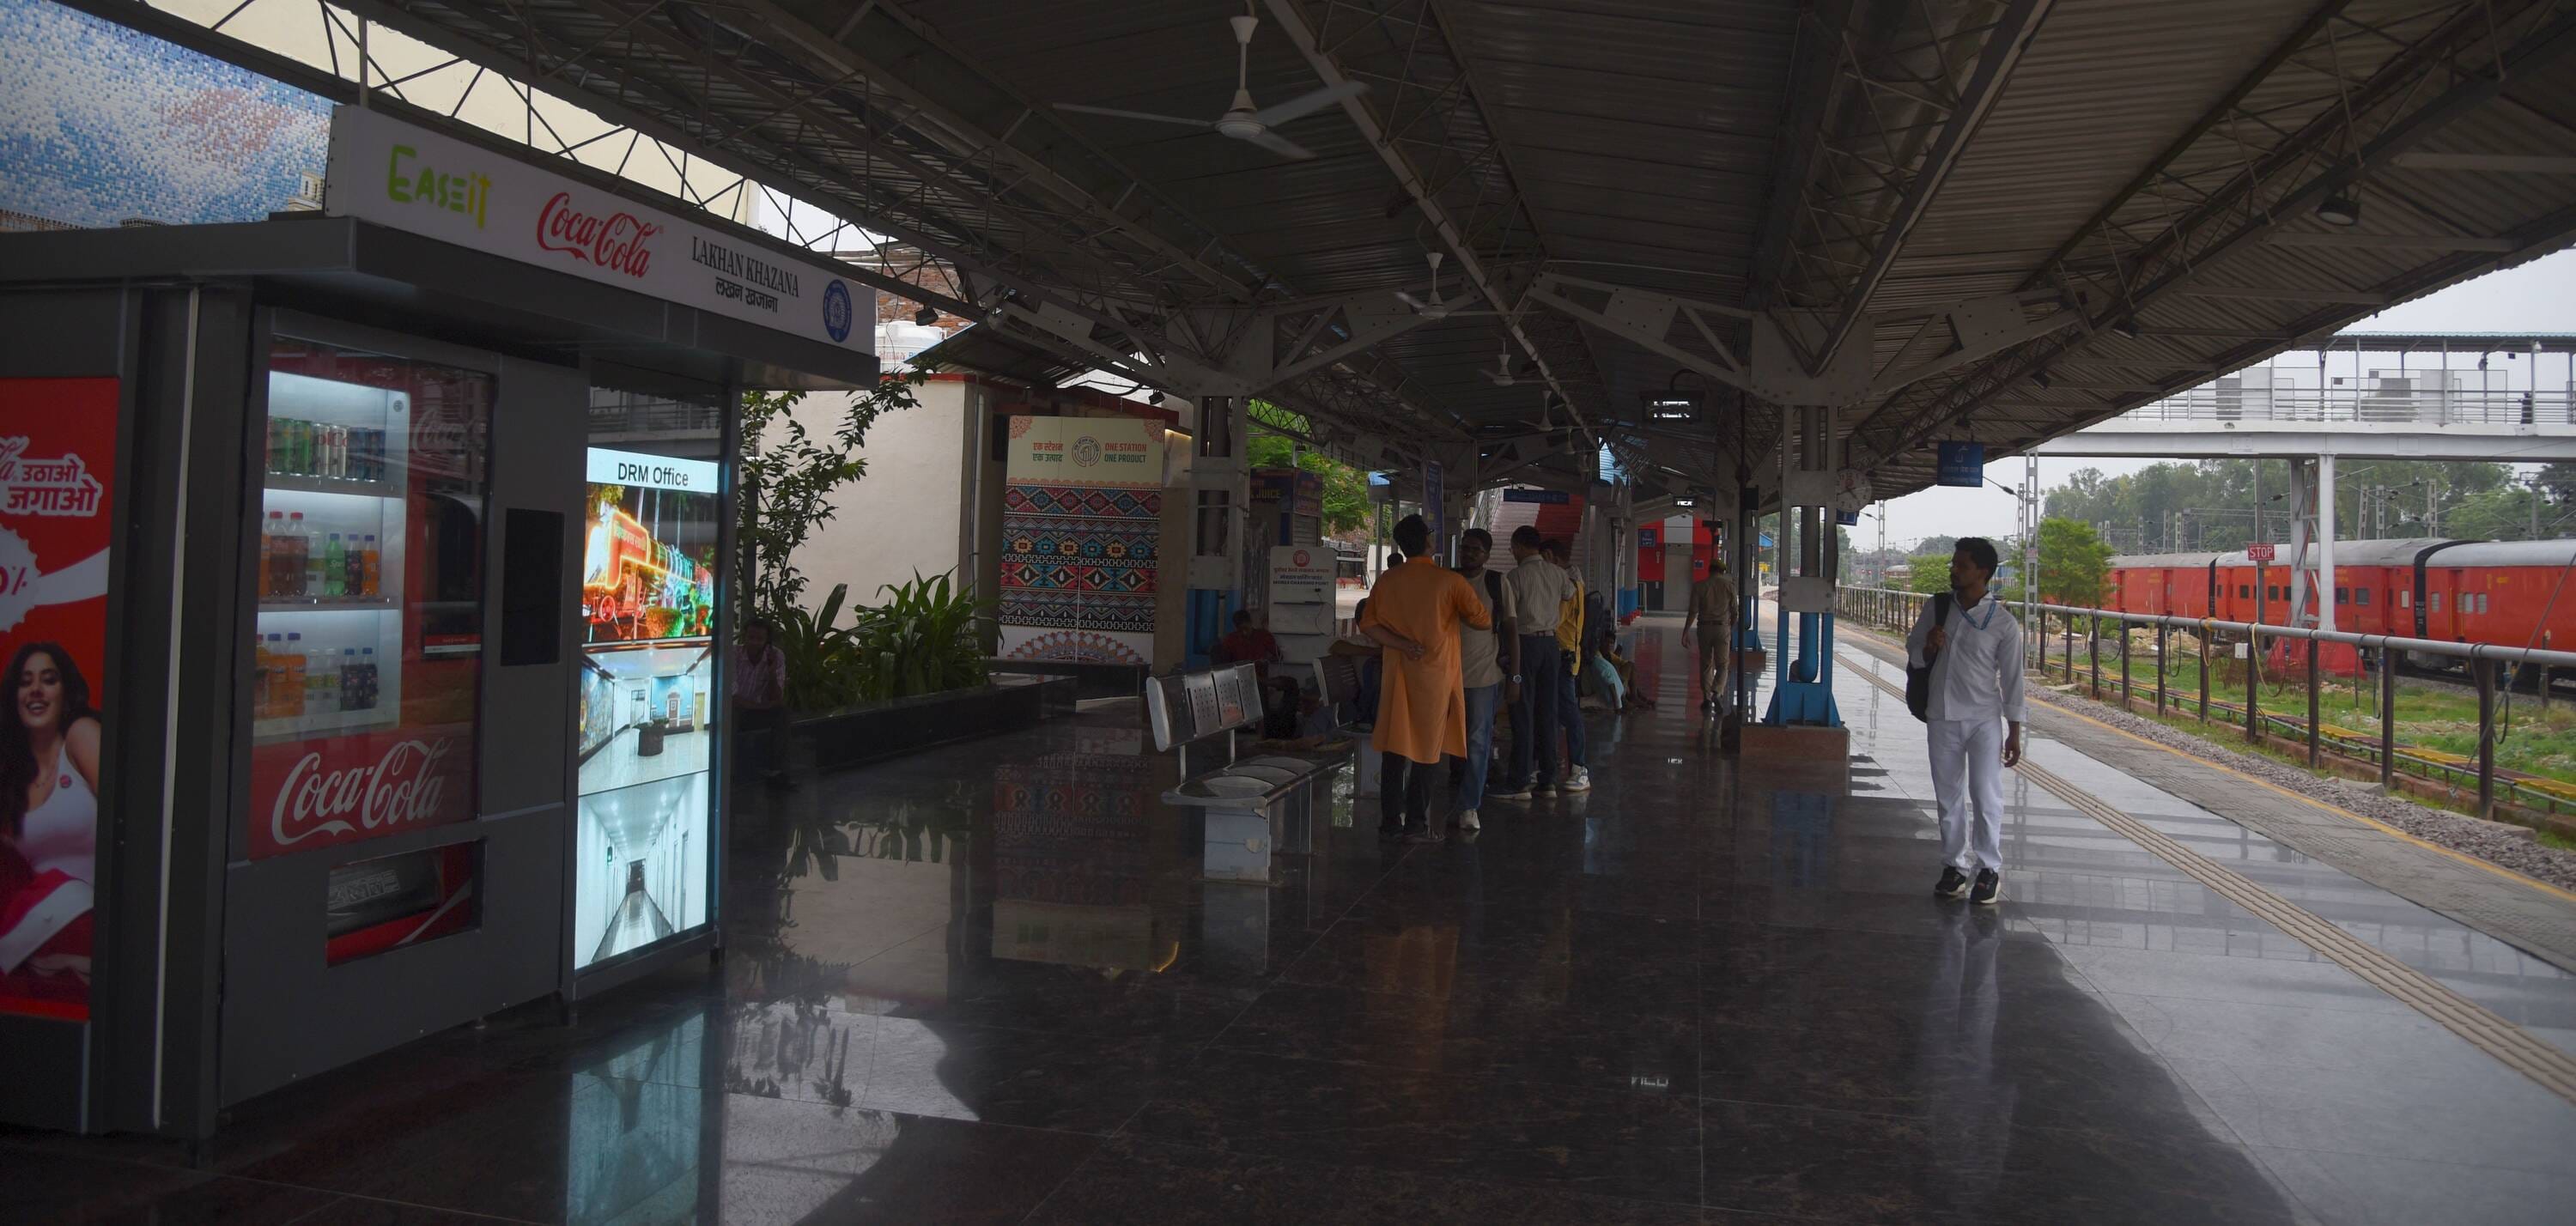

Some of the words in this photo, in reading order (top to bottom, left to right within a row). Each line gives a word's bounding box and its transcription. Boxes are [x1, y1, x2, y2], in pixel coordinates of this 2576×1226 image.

[692, 236, 744, 277] LAKHAN
[745, 257, 799, 298] KHAZANA
[715, 276, 744, 301] लखन
[744, 288, 779, 313] खजाना
[1033, 442, 1043, 451] एक
[1104, 453, 1116, 463] ONE
[1118, 454, 1146, 464] PRODUCT
[1105, 442, 1117, 452] ONE
[1119, 442, 1147, 452] STATION
[21, 458, 79, 483] उठाओ
[618, 462, 648, 483] DRM
[653, 466, 689, 486] Office
[7, 478, 98, 512] जगाओ
[2249, 546, 2274, 558] STOP
[271, 737, 453, 846] Coca-Cola
